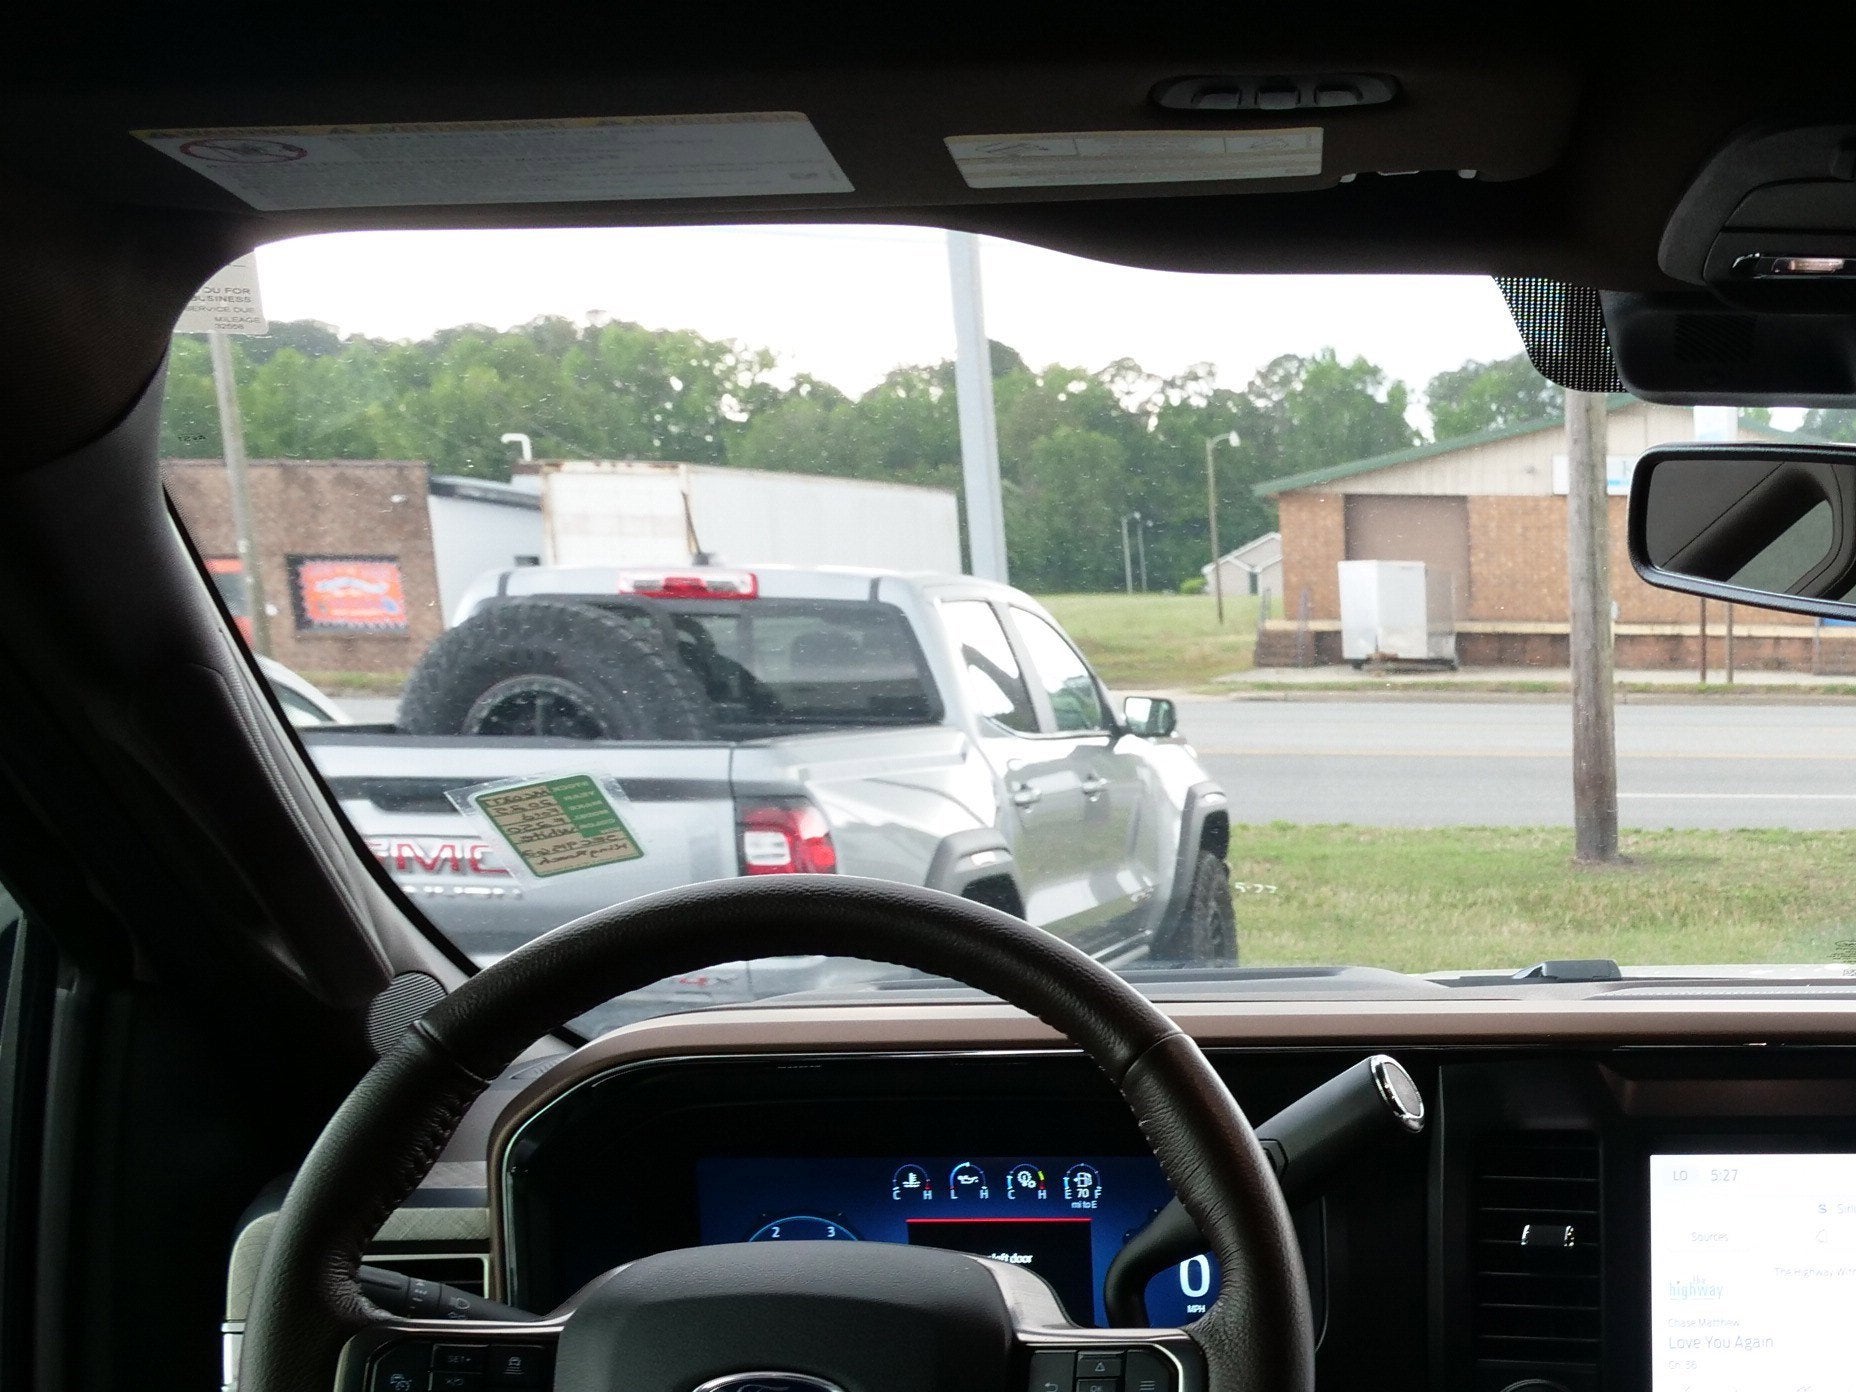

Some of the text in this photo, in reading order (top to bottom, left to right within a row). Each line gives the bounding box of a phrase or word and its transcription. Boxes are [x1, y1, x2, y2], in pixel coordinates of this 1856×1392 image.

[1711, 1170, 1738, 1182] 5:27
[772, 1226, 780, 1238] 2
[827, 1226, 836, 1238] 3
[1010, 1252, 1033, 1263] door
[1180, 1254, 1211, 1298] 0
[1187, 1304, 1206, 1313] MPH
[1668, 1336, 1774, 1351] Love You Again
